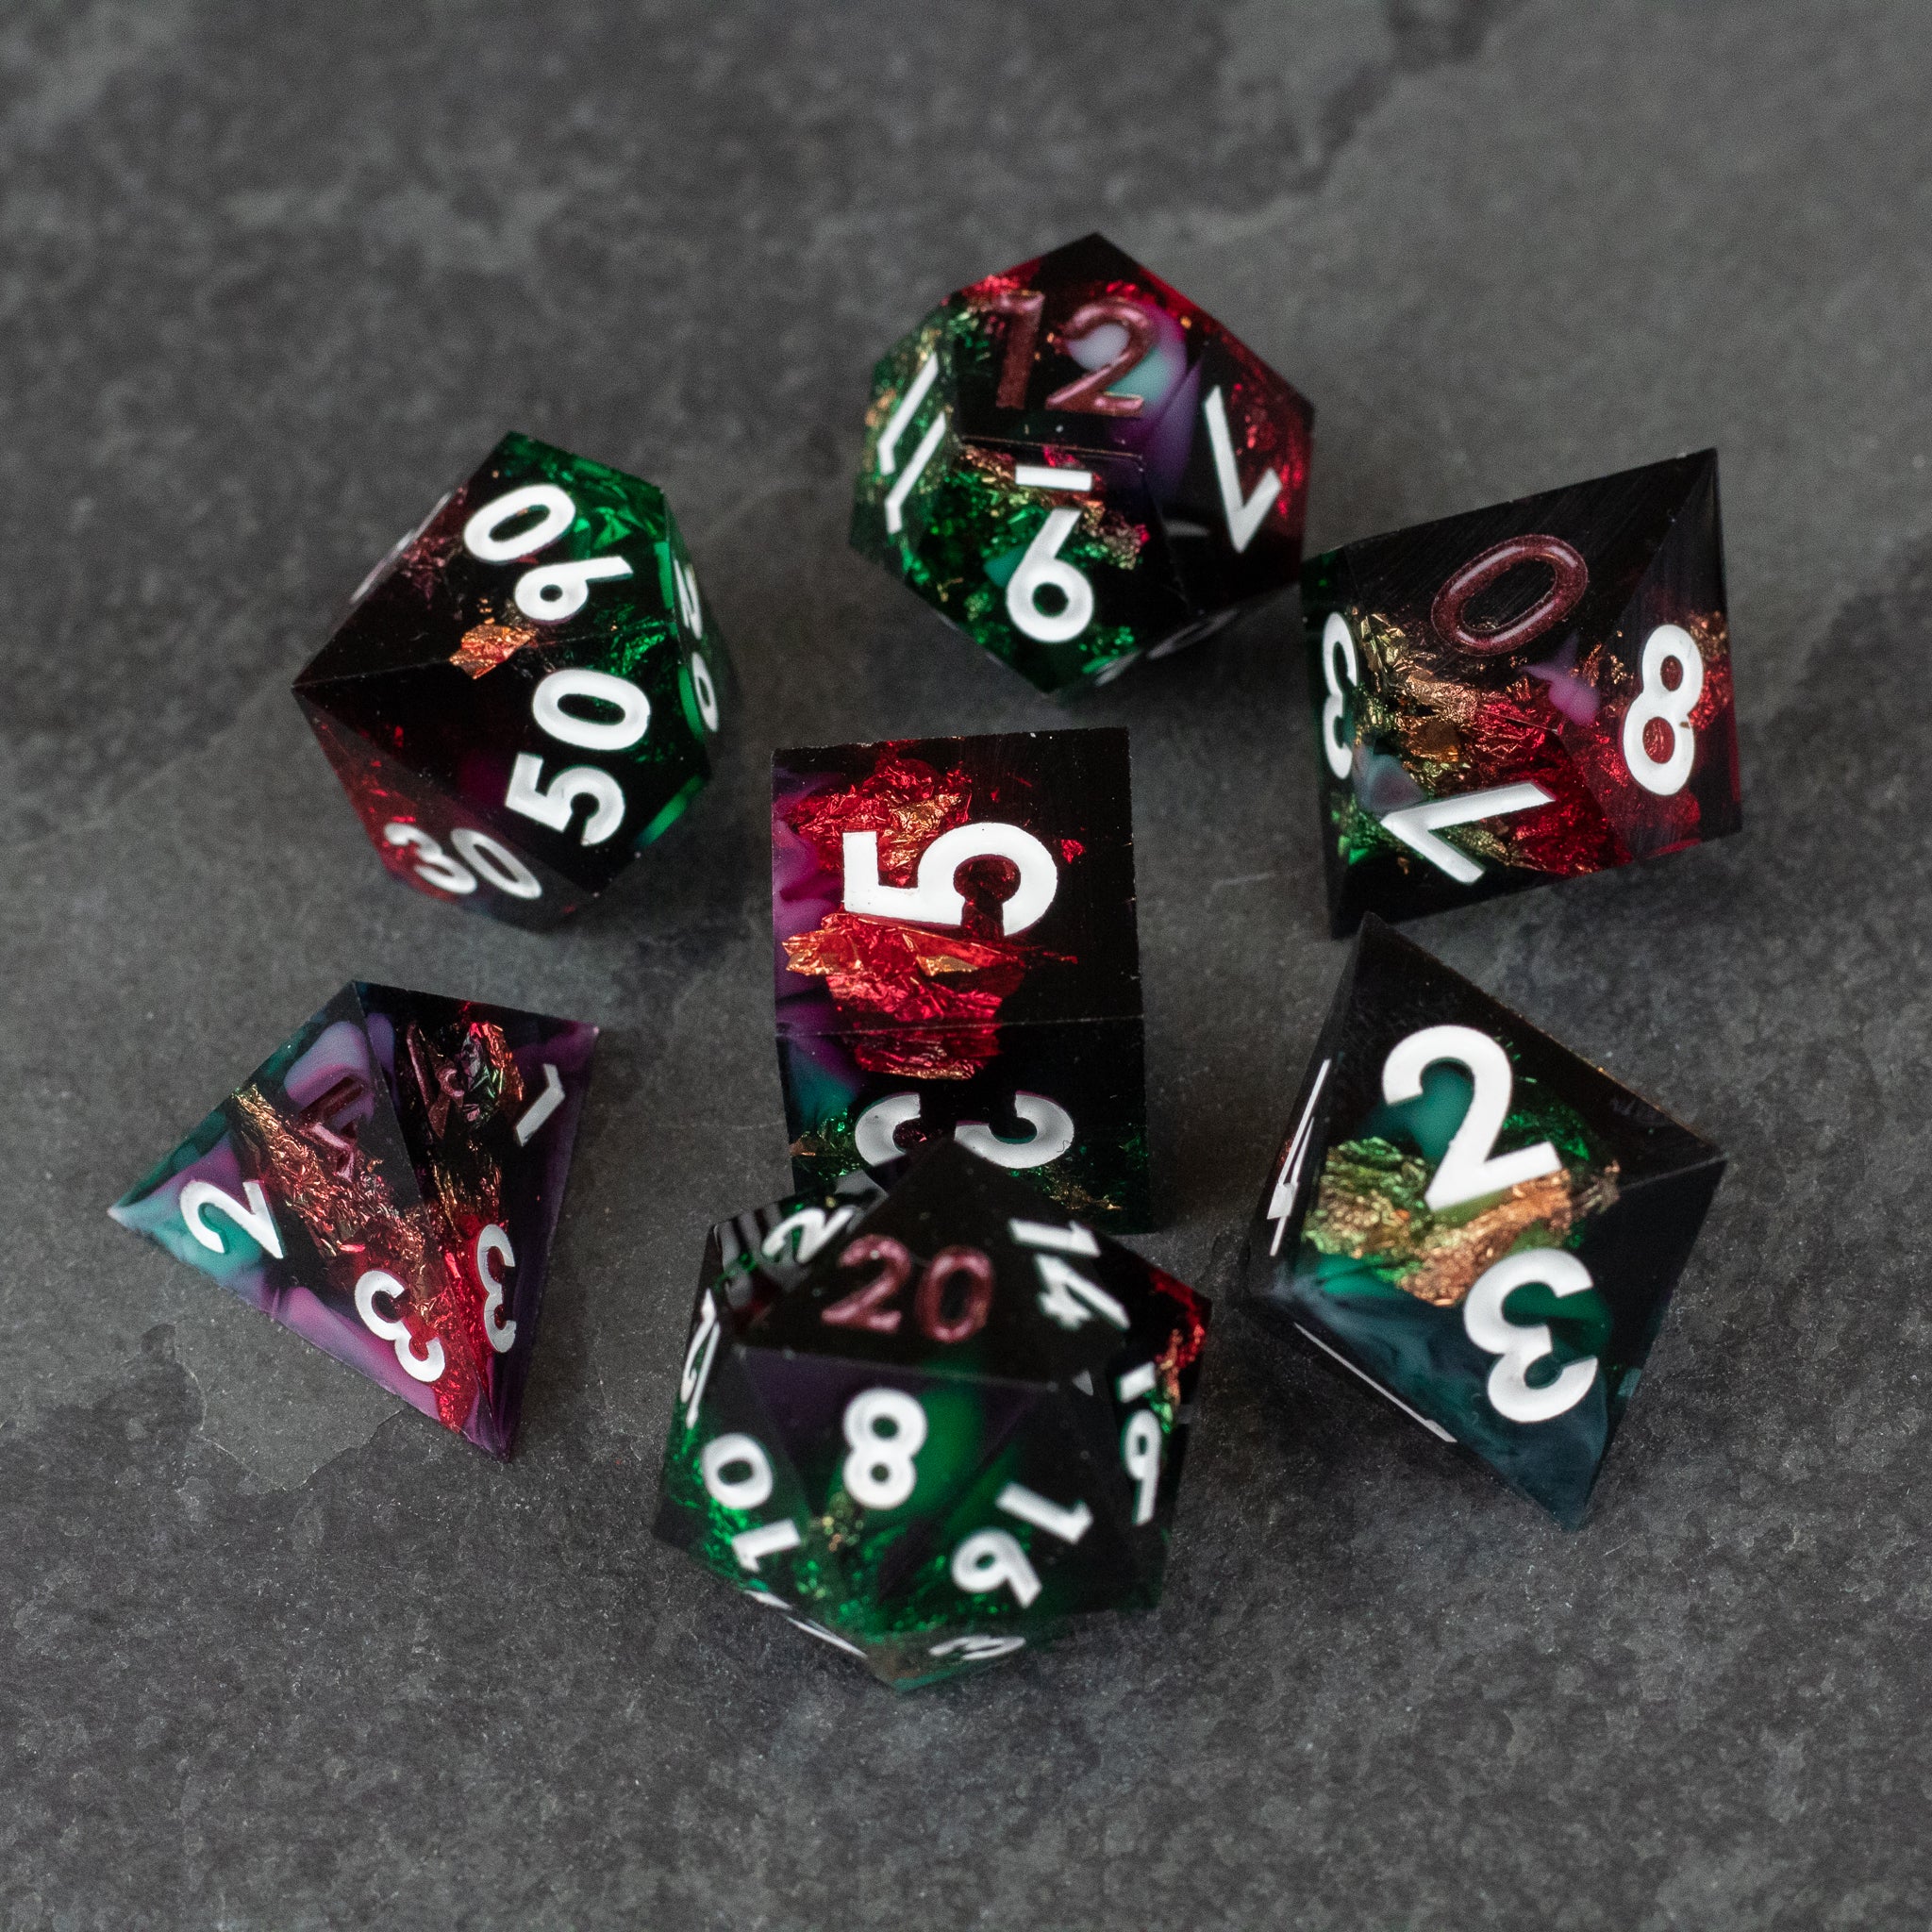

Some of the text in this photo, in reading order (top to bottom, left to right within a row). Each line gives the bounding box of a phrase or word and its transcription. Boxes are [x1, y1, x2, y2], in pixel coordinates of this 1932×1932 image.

[992, 289, 1153, 415] 12
[464, 483, 634, 625] 90
[1431, 534, 1589, 656] 0
[1323, 612, 1358, 779] 3
[1623, 624, 1704, 796] 8
[505, 668, 651, 847] 50
[384, 822, 542, 899] 30
[842, 822, 1058, 937] 5
[1380, 780, 1557, 885] 7
[1381, 1024, 1562, 1211] 2
[180, 1179, 284, 1259] 2
[761, 1207, 856, 1264] 2
[1008, 1218, 1132, 1330] 14
[354, 1270, 446, 1383] 3
[477, 1224, 518, 1353] 3
[821, 1234, 994, 1343] 20
[1463, 1248, 1599, 1423] 3
[701, 1432, 802, 1574] 10
[842, 1387, 928, 1509] 8
